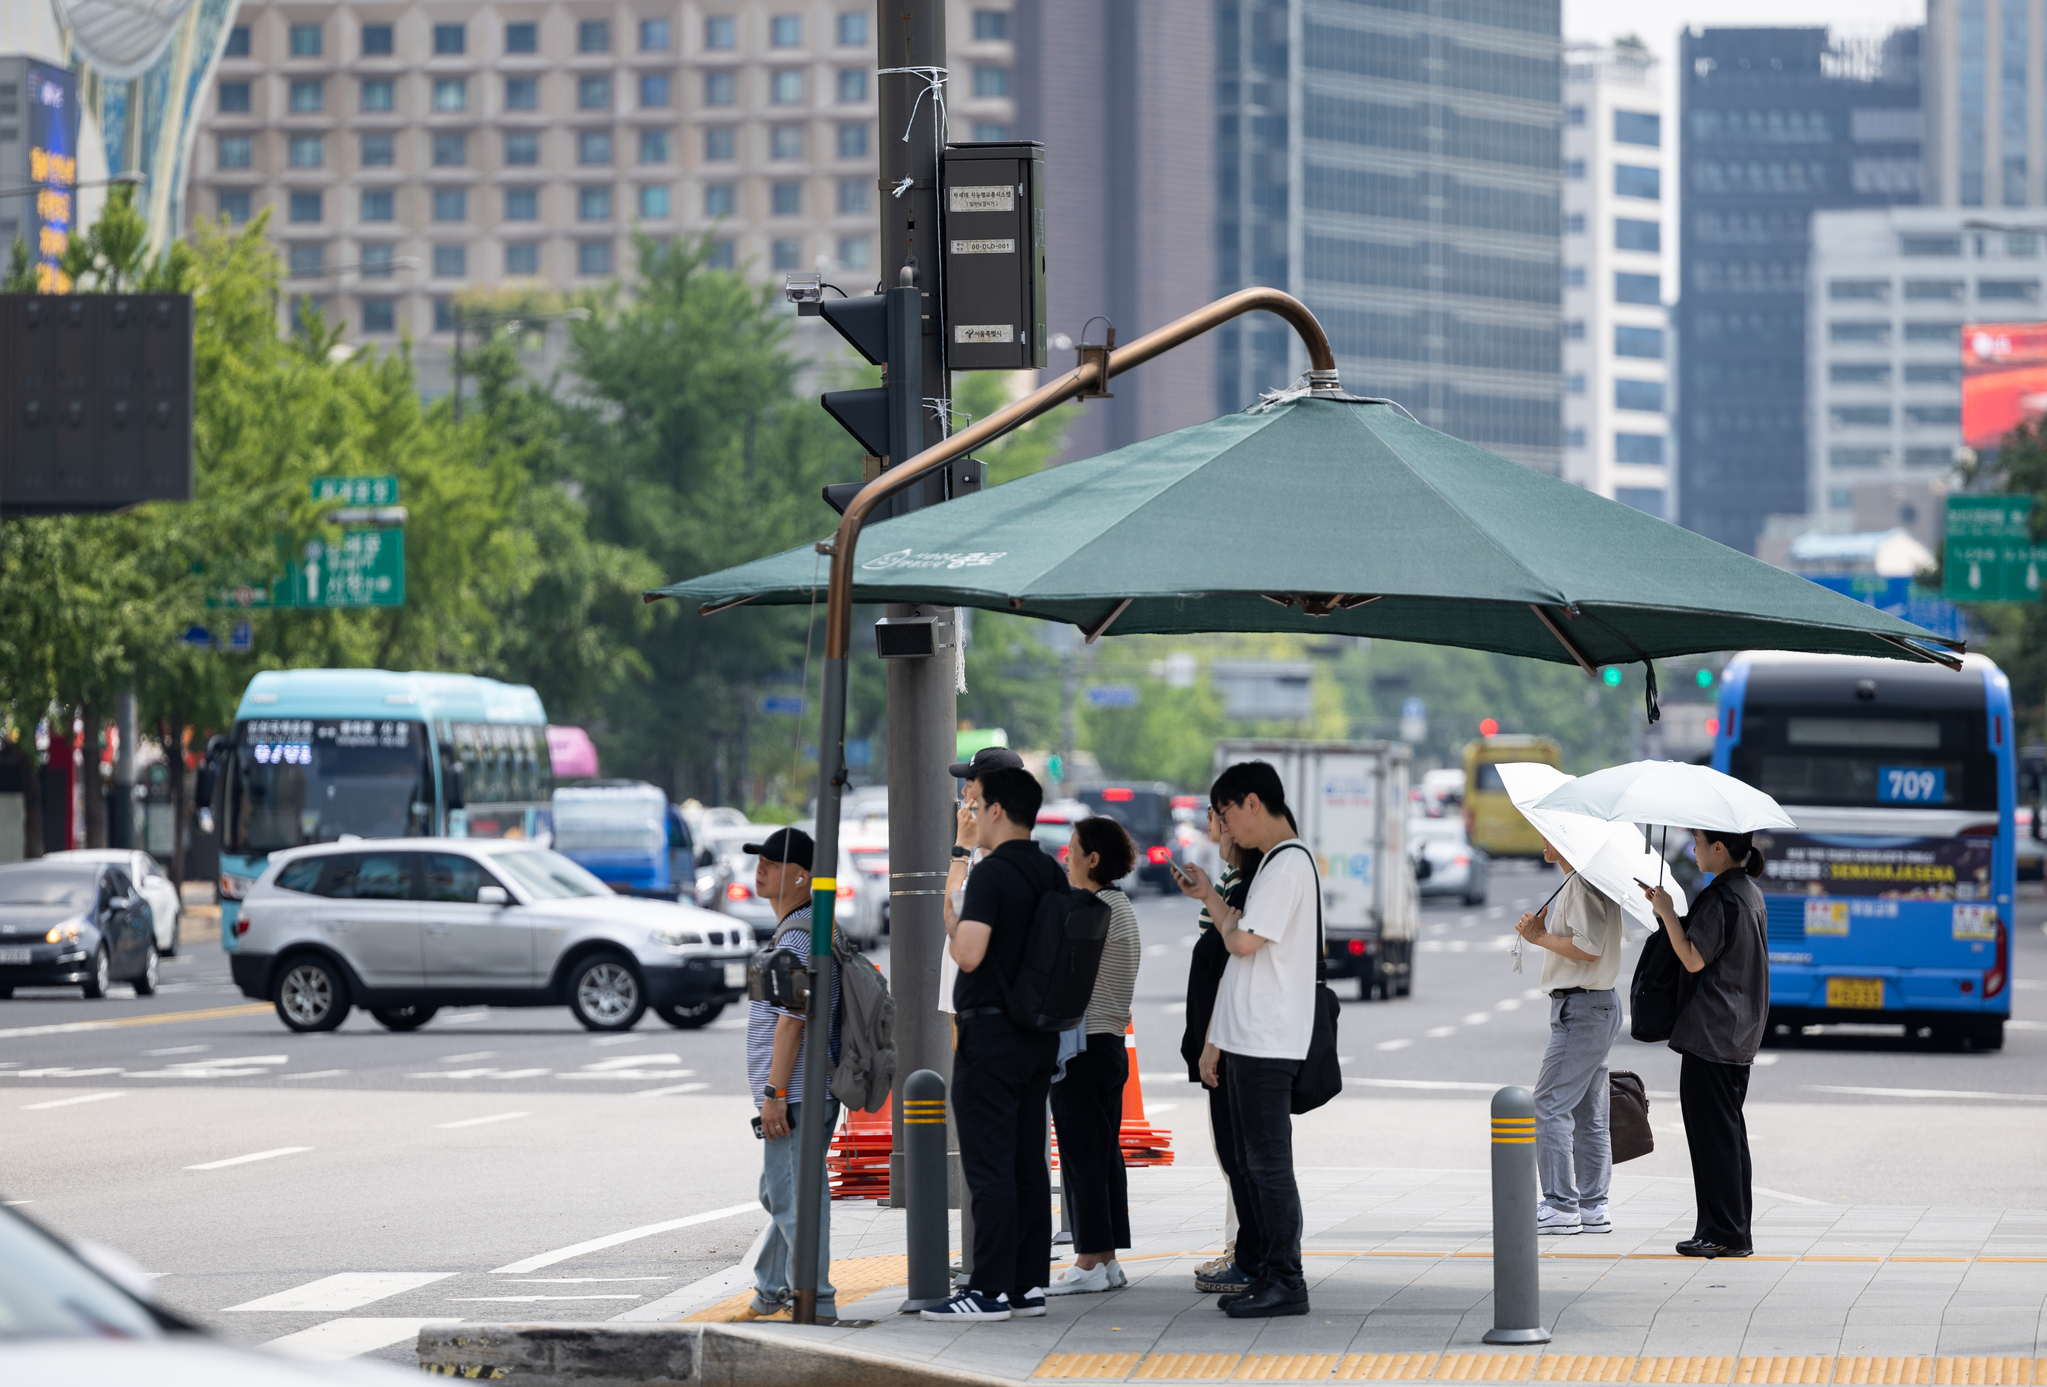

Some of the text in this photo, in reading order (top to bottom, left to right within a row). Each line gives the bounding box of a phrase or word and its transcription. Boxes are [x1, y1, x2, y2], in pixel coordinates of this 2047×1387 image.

[974, 330, 1002, 338] 서울특별시
[1888, 770, 1936, 801] 709
[1830, 863, 1956, 882] SENAHAJASENA
[1204, 1283, 1236, 1291] crocs
